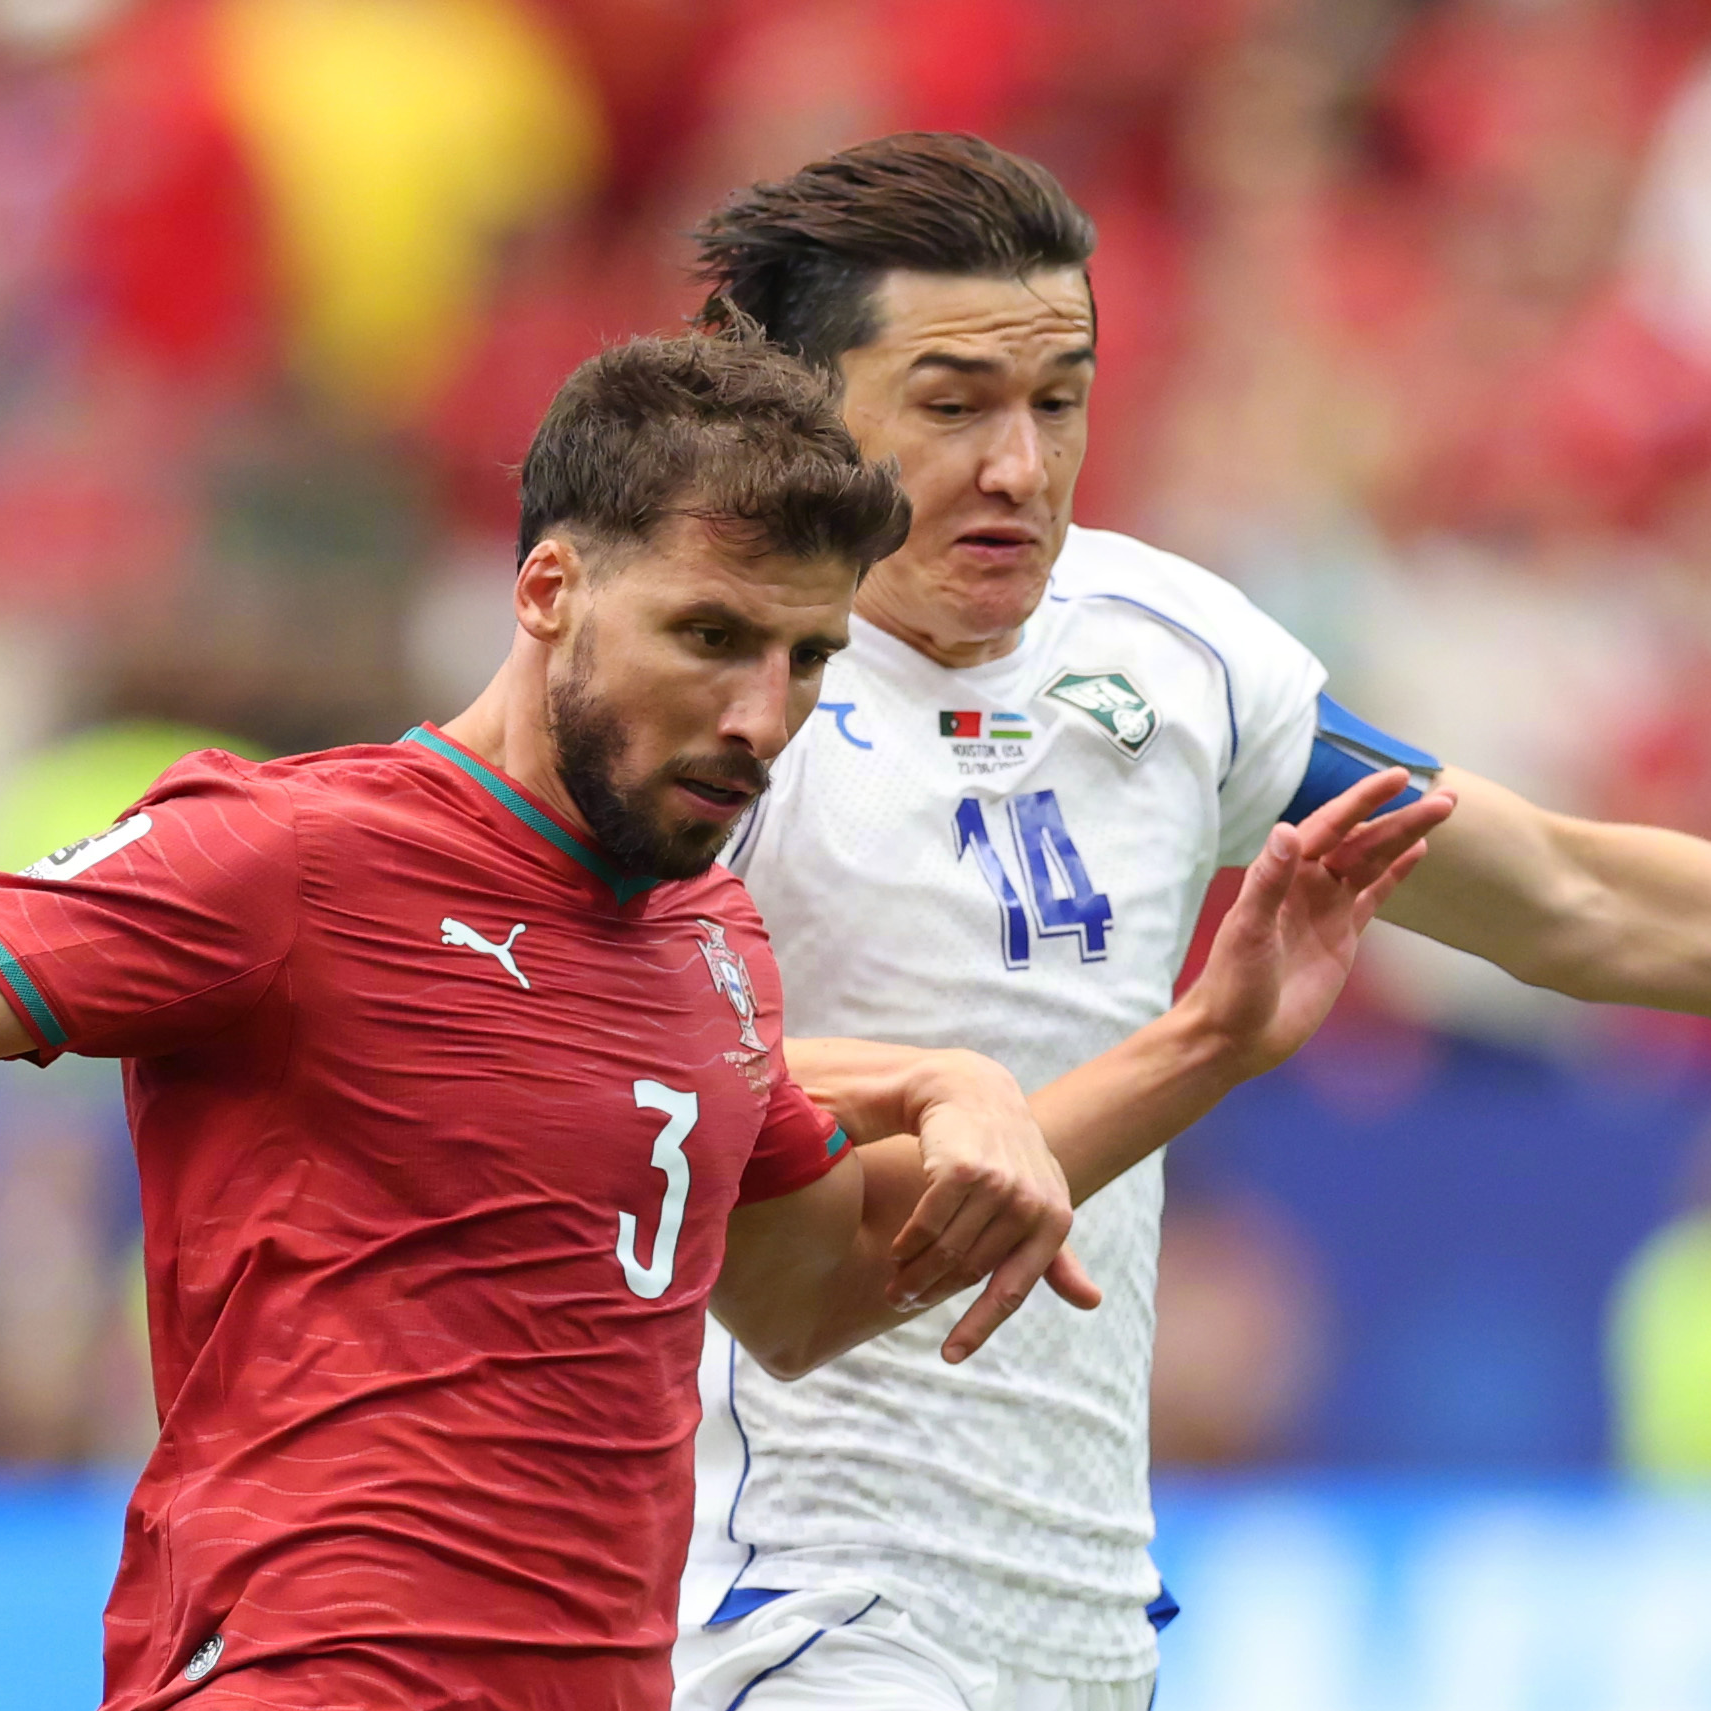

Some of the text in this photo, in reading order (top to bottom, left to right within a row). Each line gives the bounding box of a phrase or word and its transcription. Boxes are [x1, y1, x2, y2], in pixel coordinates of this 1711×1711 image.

[1001, 744, 1025, 758] USA
[951, 789, 1114, 969] 14
[615, 1078, 699, 1300] 3
